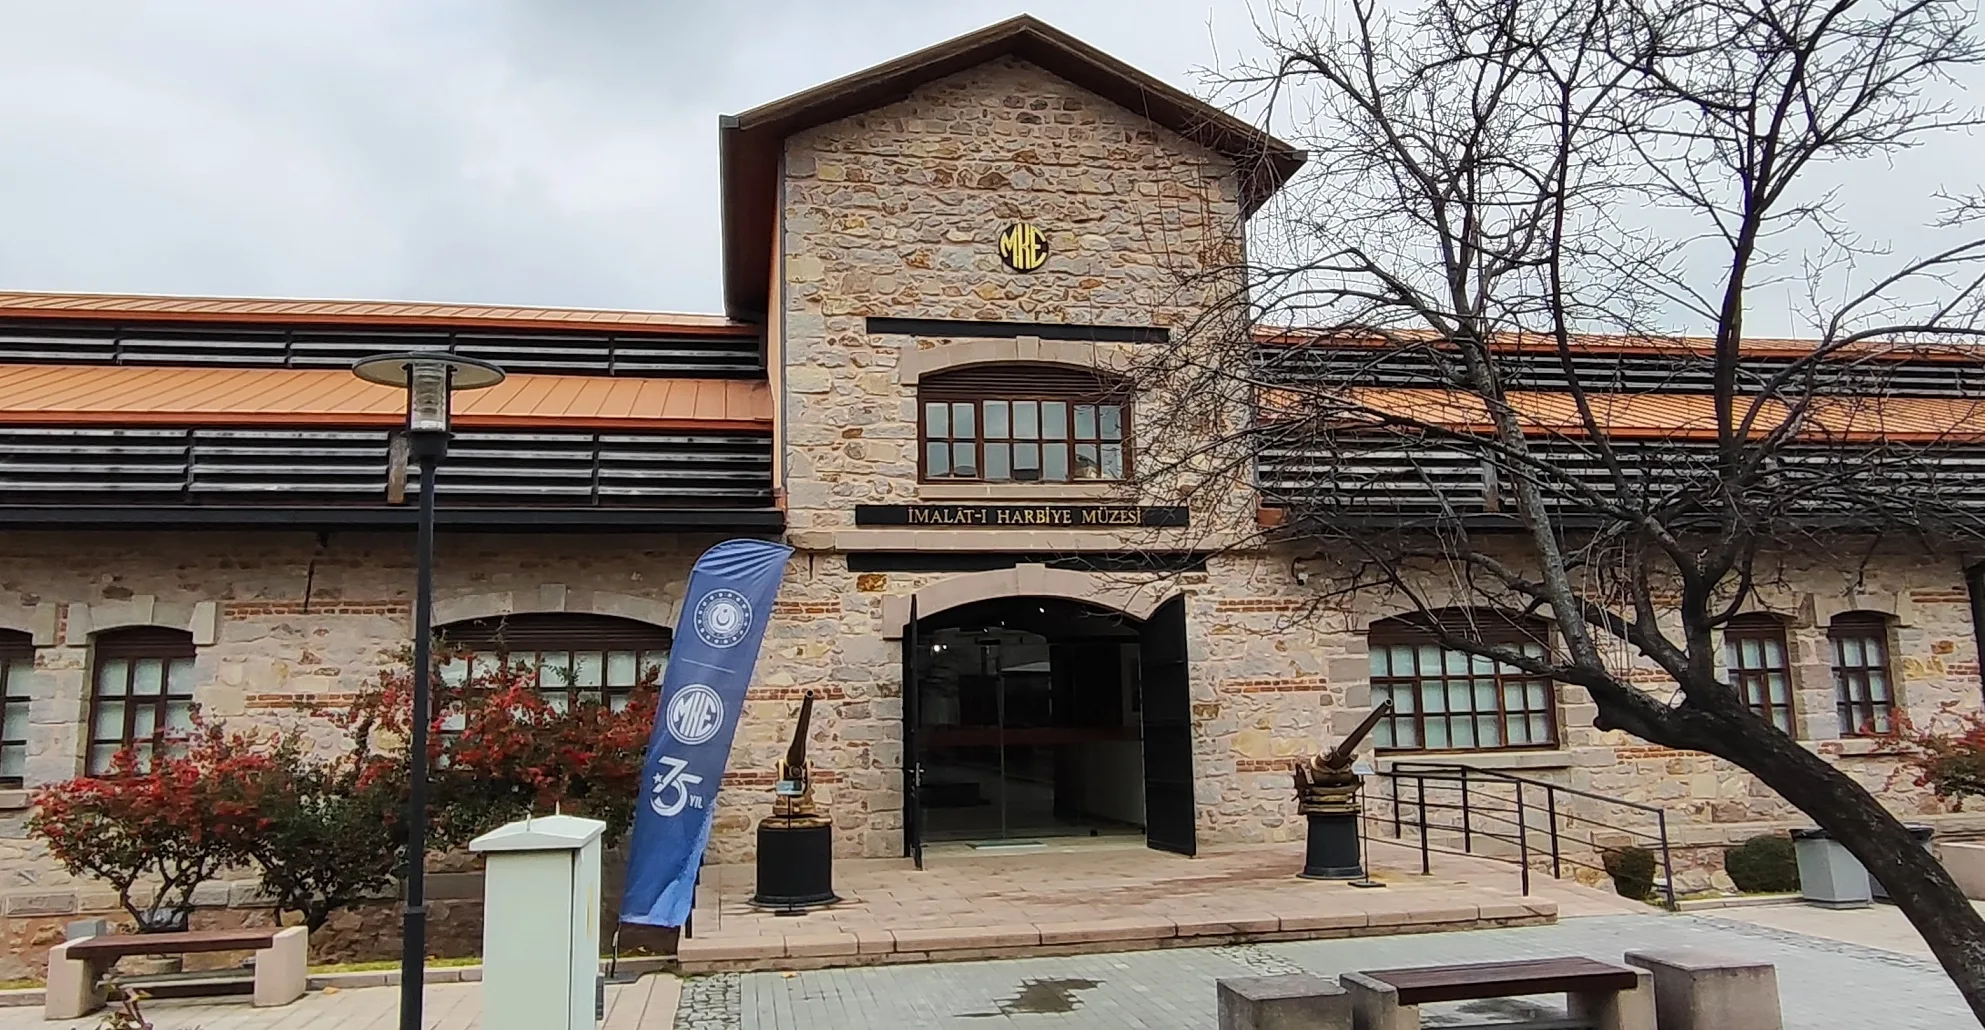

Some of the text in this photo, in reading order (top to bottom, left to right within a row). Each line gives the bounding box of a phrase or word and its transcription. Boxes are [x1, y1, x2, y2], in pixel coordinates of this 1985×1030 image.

[1000, 223, 1047, 270] MKE
[908, 506, 1142, 524] İMALÂT-I HARBİYE MÜZESİ
[689, 794, 703, 809] YIL
